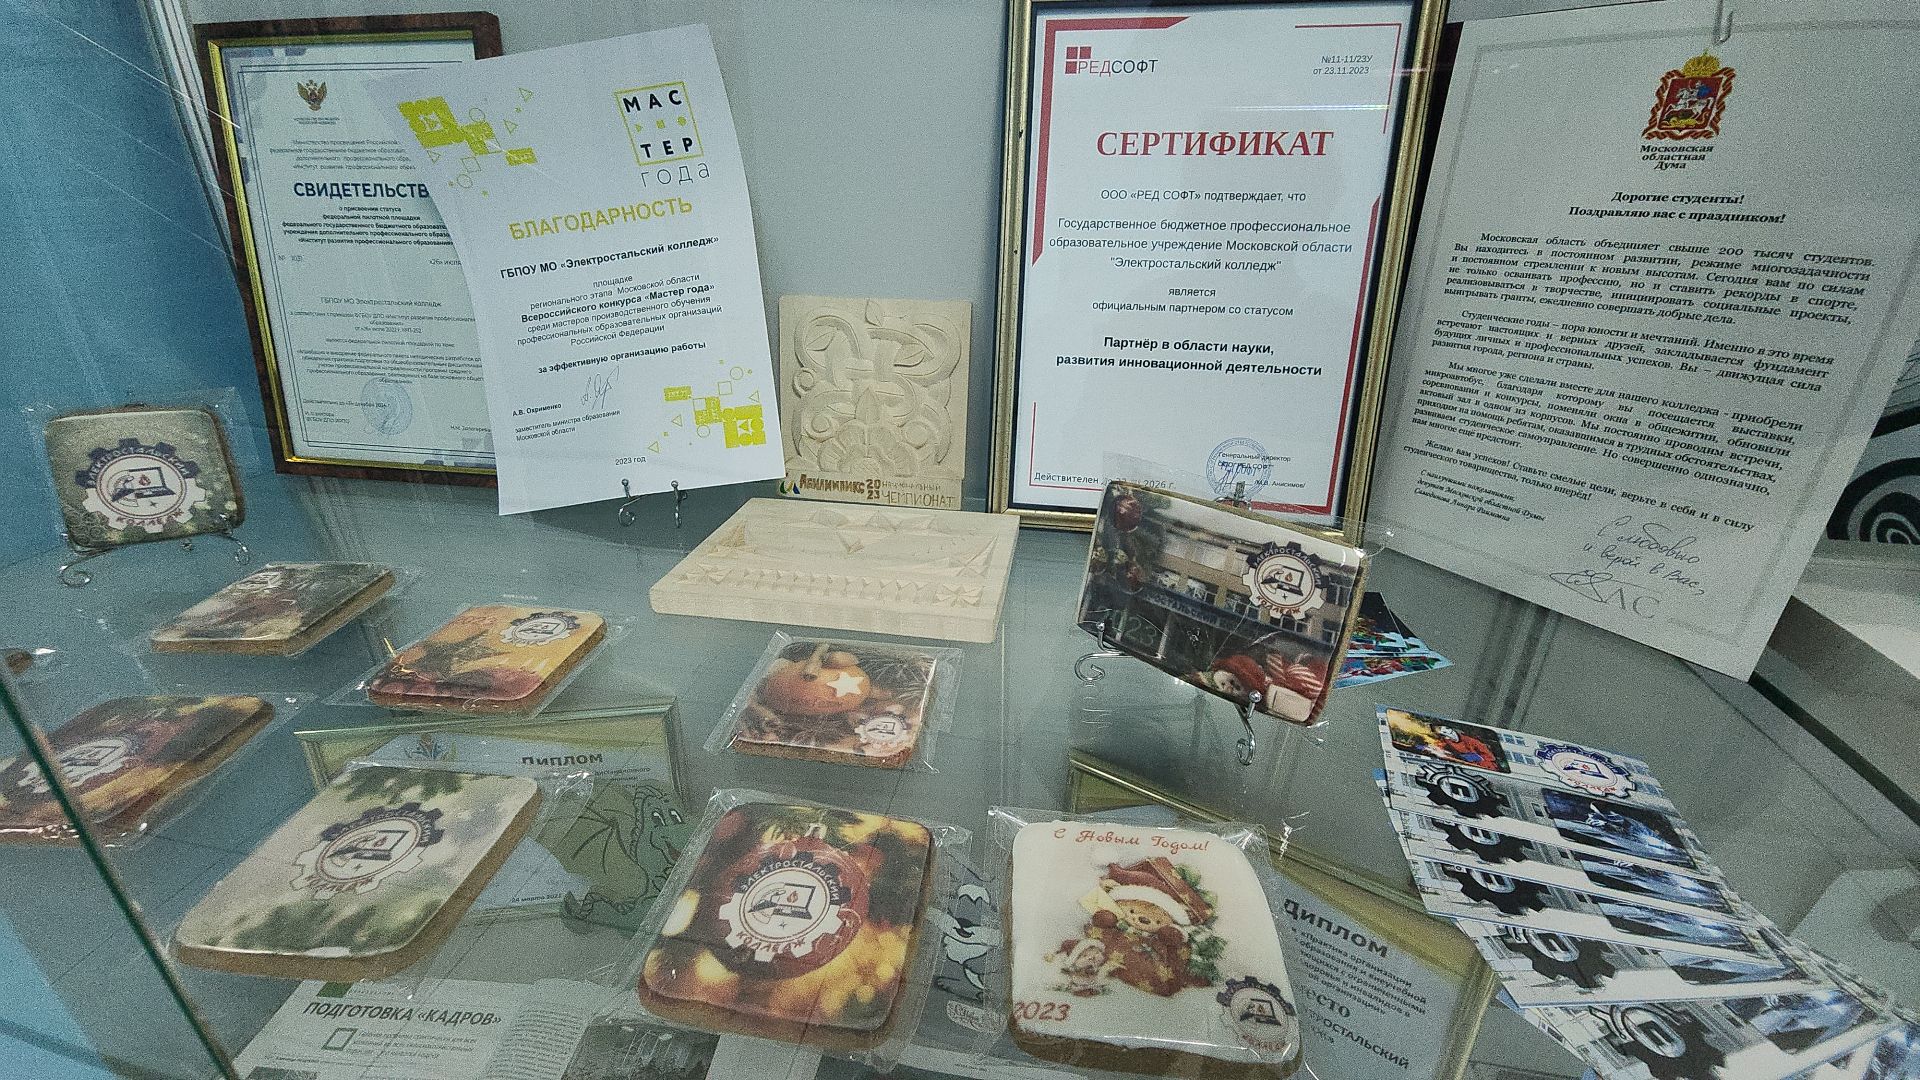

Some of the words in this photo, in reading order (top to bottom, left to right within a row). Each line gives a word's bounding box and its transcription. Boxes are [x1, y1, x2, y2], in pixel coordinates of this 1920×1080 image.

[1077, 58, 1159, 77] РЕДСОФТ
[1312, 66, 1322, 75] от
[1324, 65, 1370, 76] 23.11.2023
[622, 88, 683, 114] МАС
[640, 136, 695, 159] ТЕР
[1096, 130, 1334, 157] СЕРТИФИКАТ
[1640, 145, 1714, 154] Московская
[1642, 153, 1706, 162] областная
[1654, 161, 1687, 171] Дума
[640, 162, 711, 188] года
[1101, 189, 1128, 201] ООО
[1130, 189, 1160, 203] «РЕД
[1163, 190, 1201, 202] СОФТ»
[1204, 190, 1284, 204] подтверждает,
[1288, 192, 1307, 202] что
[1611, 191, 1669, 204] Дорогие
[1671, 194, 1745, 205] студенты!
[509, 196, 694, 241] БЛАГОДАРНОСТЬ
[1569, 206, 1650, 220] Поздравляю
[1653, 211, 1676, 219] вас
[1678, 211, 1687, 219] с
[1688, 212, 1786, 224] праздником!
[1057, 217, 1156, 232] Государственное
[1160, 219, 1227, 234] бюджетное
[1229, 220, 1351, 235] профессиональное
[1049, 237, 1148, 250] образовательное
[1151, 239, 1223, 253] учреждение
[1226, 240, 1298, 253] Московской
[1301, 241, 1353, 254] области
[1480, 232, 1539, 244] Московская
[1546, 237, 1587, 248] область
[1593, 238, 1661, 251] объединяет
[1668, 244, 1710, 254] свыше
[1718, 247, 1744, 256] 200
[1753, 249, 1795, 260] тысяч
[1803, 252, 1876, 267] студентов.
[500, 264, 537, 279] ГБПОУ
[540, 261, 557, 274] МО
[561, 244, 665, 270] «Электростальский
[667, 235, 719, 253] колледж»
[1110, 256, 1222, 272] "Электростальский
[1224, 258, 1282, 273] колледж"
[1454, 243, 1468, 252] Вы
[1475, 244, 1529, 256] находитесь
[1550, 250, 1616, 262] постоянном
[1623, 254, 1682, 267] развитии,
[1690, 258, 1742, 270] режиме
[1751, 262, 1871, 282] многозадачности
[592, 274, 634, 289] площадке
[1462, 255, 1519, 267] постоянном
[1523, 260, 1585, 272] стремлении
[1602, 266, 1640, 276] новым
[1645, 268, 1699, 281] высотам.
[1706, 272, 1759, 287] Сегодня
[1765, 278, 1791, 289] вам
[1797, 281, 1816, 292] по
[1821, 283, 1866, 296] силам
[530, 293, 588, 311] регионального
[590, 288, 613, 300] этапа
[617, 279, 664, 295] Московской
[666, 274, 700, 287] области
[1168, 287, 1216, 298] является
[1449, 266, 1460, 274] не
[1466, 266, 1498, 278] только
[1503, 270, 1553, 282] осваивать
[1559, 274, 1622, 288] профессию,
[1630, 281, 1646, 290] но
[1652, 283, 1661, 291] и
[1669, 283, 1716, 296] ставить
[1723, 288, 1782, 303] рекорды
[1790, 294, 1799, 303] в
[1807, 296, 1859, 311] спорте,
[521, 303, 597, 323] Всероссийского
[599, 294, 642, 310] конкурса
[644, 287, 685, 302] «Мастер
[686, 282, 715, 297] года»
[1092, 300, 1166, 315] официальным
[1168, 303, 1226, 316] партнером
[1228, 306, 1241, 314] со
[1244, 306, 1294, 318] статусом
[527, 322, 550, 334] среди
[552, 316, 590, 330] мастеров
[592, 301, 669, 323] производственного
[670, 294, 711, 309] обучения
[517, 326, 593, 347] профессиональных
[594, 313, 666, 332] образовательных
[668, 305, 722, 320] организаций
[570, 331, 617, 347] Российской
[618, 324, 665, 339] Федерации
[1103, 336, 1158, 353] Партнёр
[1162, 340, 1170, 350] в
[1172, 338, 1228, 352] области
[1232, 342, 1274, 356] науки,
[538, 366, 548, 375] за
[549, 354, 609, 374] эффективную
[610, 346, 670, 364] организацию
[671, 340, 706, 354] работы
[1056, 354, 1115, 368] развития
[1118, 355, 1223, 372] инновационной
[1225, 360, 1322, 376] деятельности
[512, 408, 526, 418] А.В.
[526, 402, 562, 416] Охрименко
[515, 420, 552, 434] заместитель
[552, 416, 582, 428] министра
[582, 409, 622, 423] образования
[516, 430, 550, 442] Московской
[552, 427, 576, 438] области
[615, 457, 633, 466] 2023
[634, 456, 647, 466] год
[866, 478, 881, 490] 20
[1034, 472, 1099, 484] Действителен
[1144, 479, 1166, 489] 2026
[866, 490, 880, 500] 23
[881, 490, 957, 508] ЧЕМПИОНАТ
[1053, 828, 1066, 839] С
[1076, 829, 1140, 846] Новым
[1150, 834, 1210, 854] Годом!
[741, 858, 840, 900] ЭЛЕКТРОСТАЛЬСКИЙ
[304, 1002, 413, 1022] ПОДГОТОВКА
[418, 1010, 502, 1026] «КАДРОВ»
[1013, 1001, 1072, 1022] 2023
